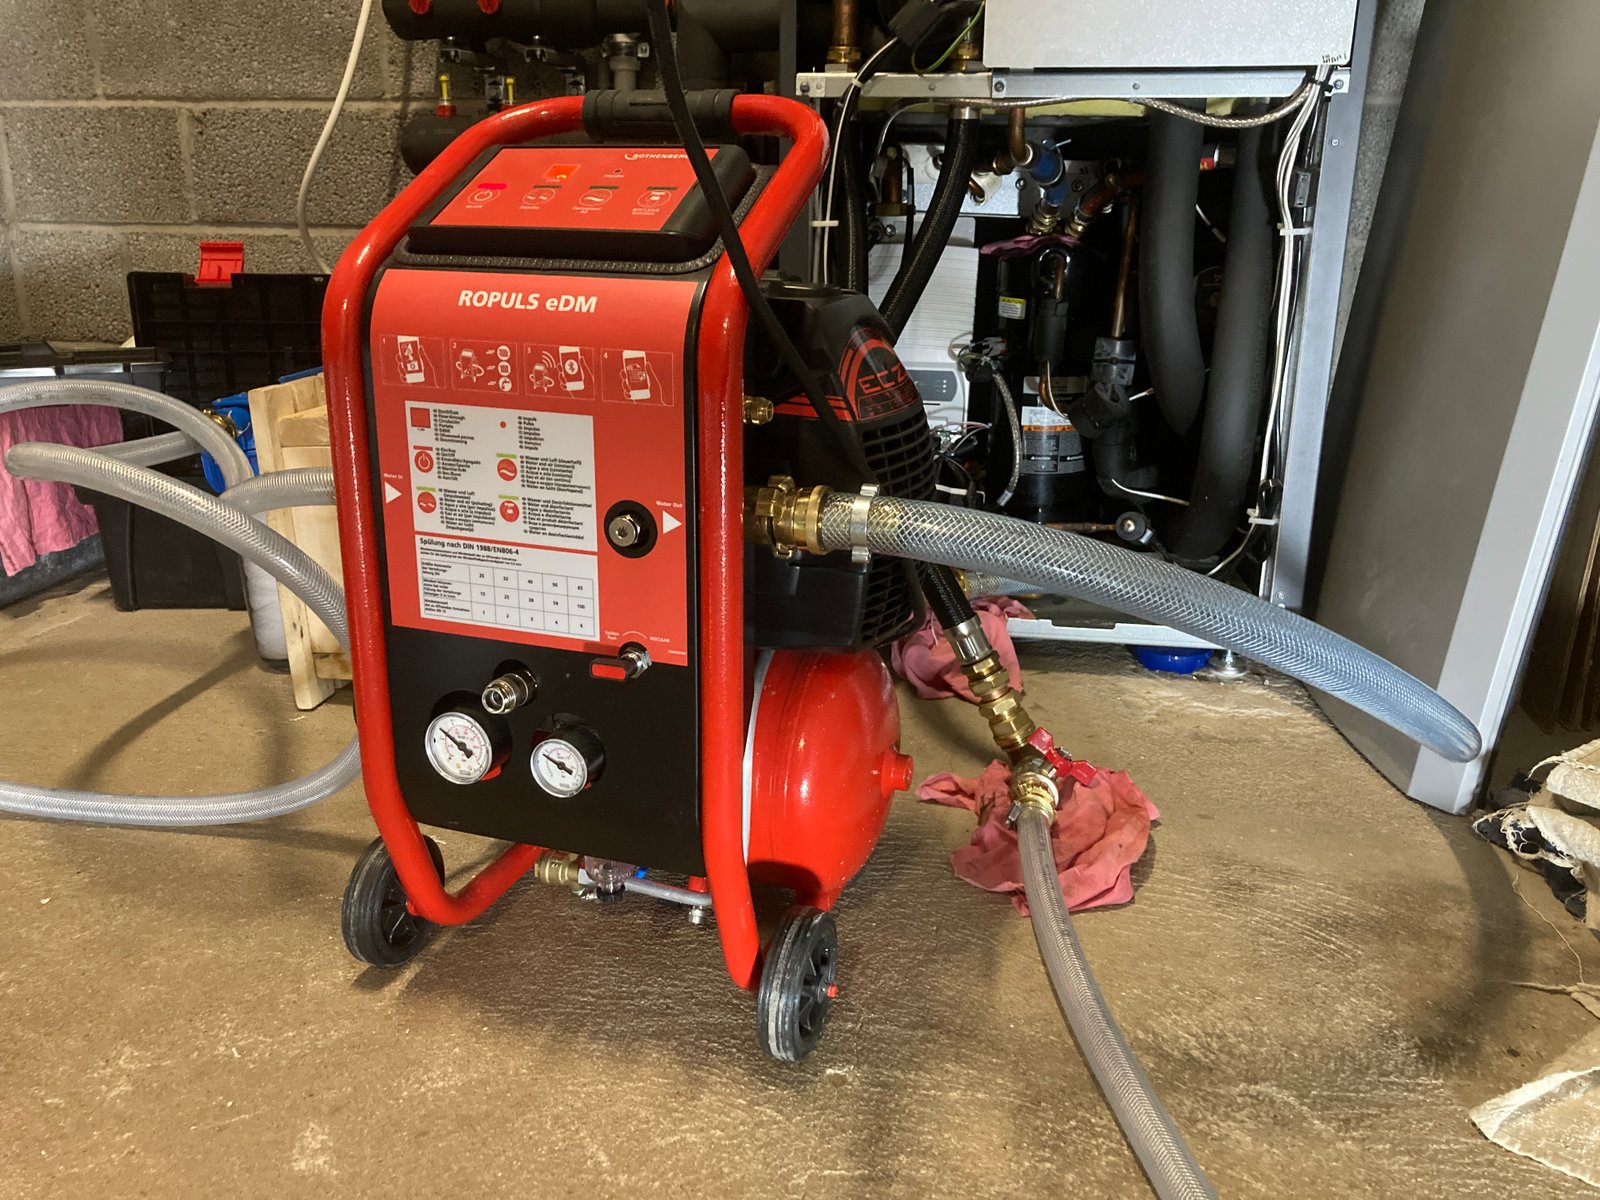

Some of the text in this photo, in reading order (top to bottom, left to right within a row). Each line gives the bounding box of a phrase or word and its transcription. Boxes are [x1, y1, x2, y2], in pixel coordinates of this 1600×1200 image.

[458, 289, 597, 313] ROPULS eDM
[420, 538, 445, 548] Spülung
[476, 545, 519, 555] 1988/EN806-4
